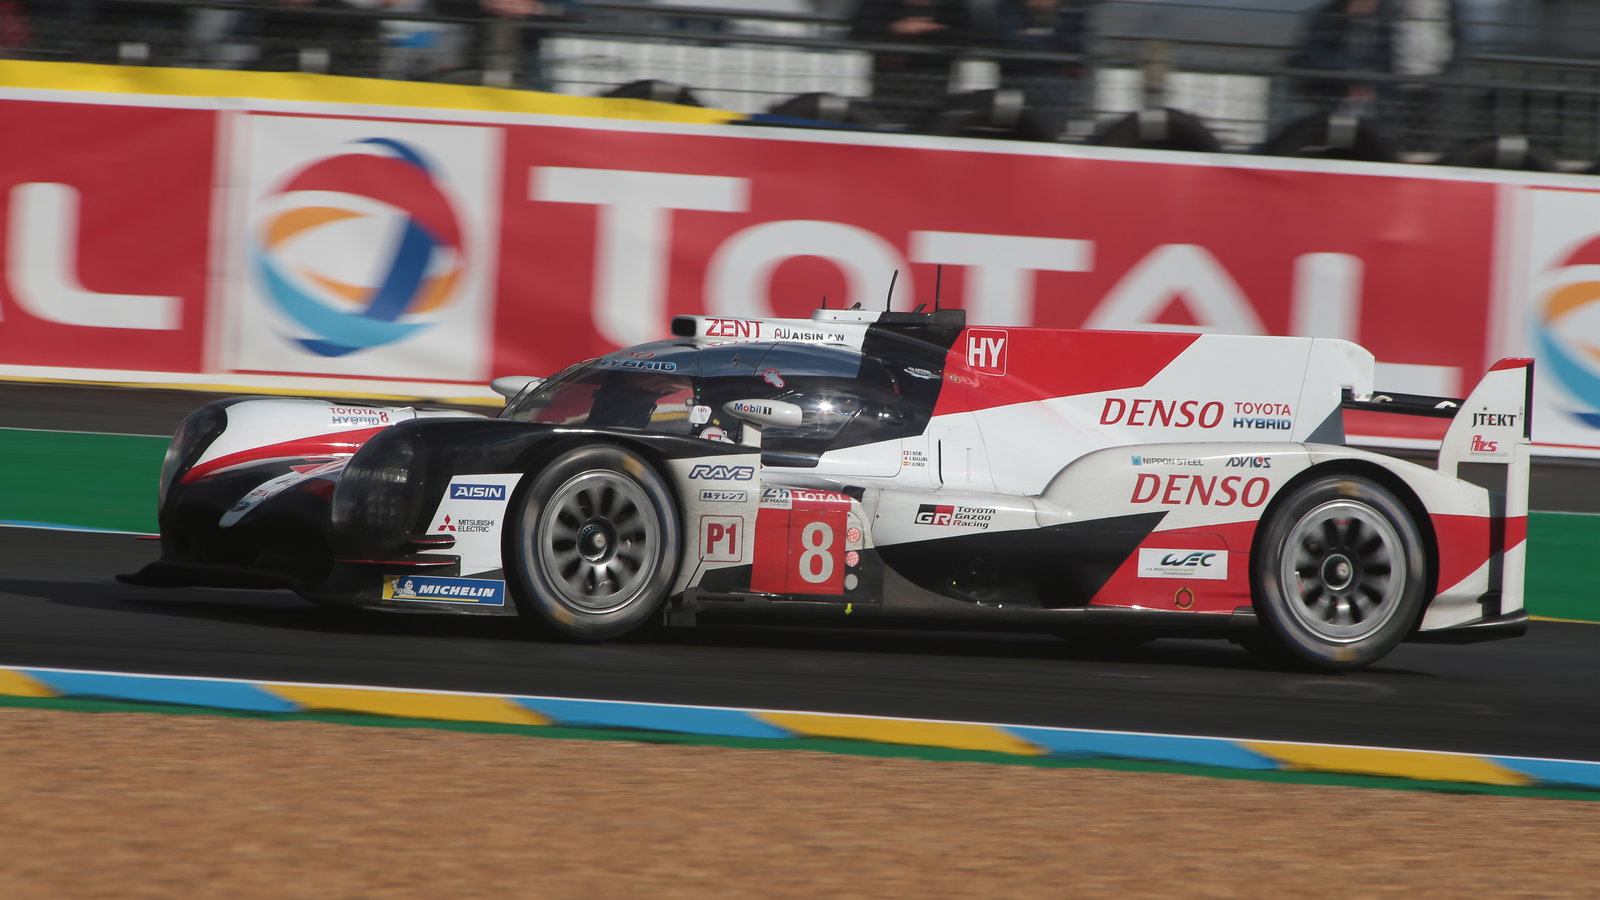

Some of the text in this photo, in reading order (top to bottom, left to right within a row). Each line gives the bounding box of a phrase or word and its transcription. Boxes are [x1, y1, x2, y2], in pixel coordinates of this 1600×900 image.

[705, 318, 764, 338] ZENT
[792, 332, 824, 341] AISIN
[968, 336, 1005, 368] HY
[329, 407, 389, 423] TOYOTA 8
[734, 402, 761, 414] Mobil
[1099, 397, 1224, 429] DENSO
[1234, 401, 1292, 416] TOYOTA
[332, 416, 379, 425] HYBRID
[1232, 417, 1292, 430] HYBRID
[1471, 413, 1517, 428] JTEKT
[1142, 457, 1204, 467] NIPPON STEEL
[688, 464, 755, 480] RAYS
[454, 486, 502, 498] AISIN
[793, 490, 844, 502] TOTAL
[1130, 473, 1270, 508] DENSO
[954, 513, 992, 521] GAZOO
[957, 506, 996, 514] TOYOTA
[458, 519, 495, 528] MITSUBISHI
[916, 512, 952, 526] GR
[953, 520, 989, 530] Racing
[706, 523, 737, 555] P1
[799, 521, 834, 584] 8
[1160, 552, 1217, 567] WEC
[418, 584, 496, 598] MICHELIN
